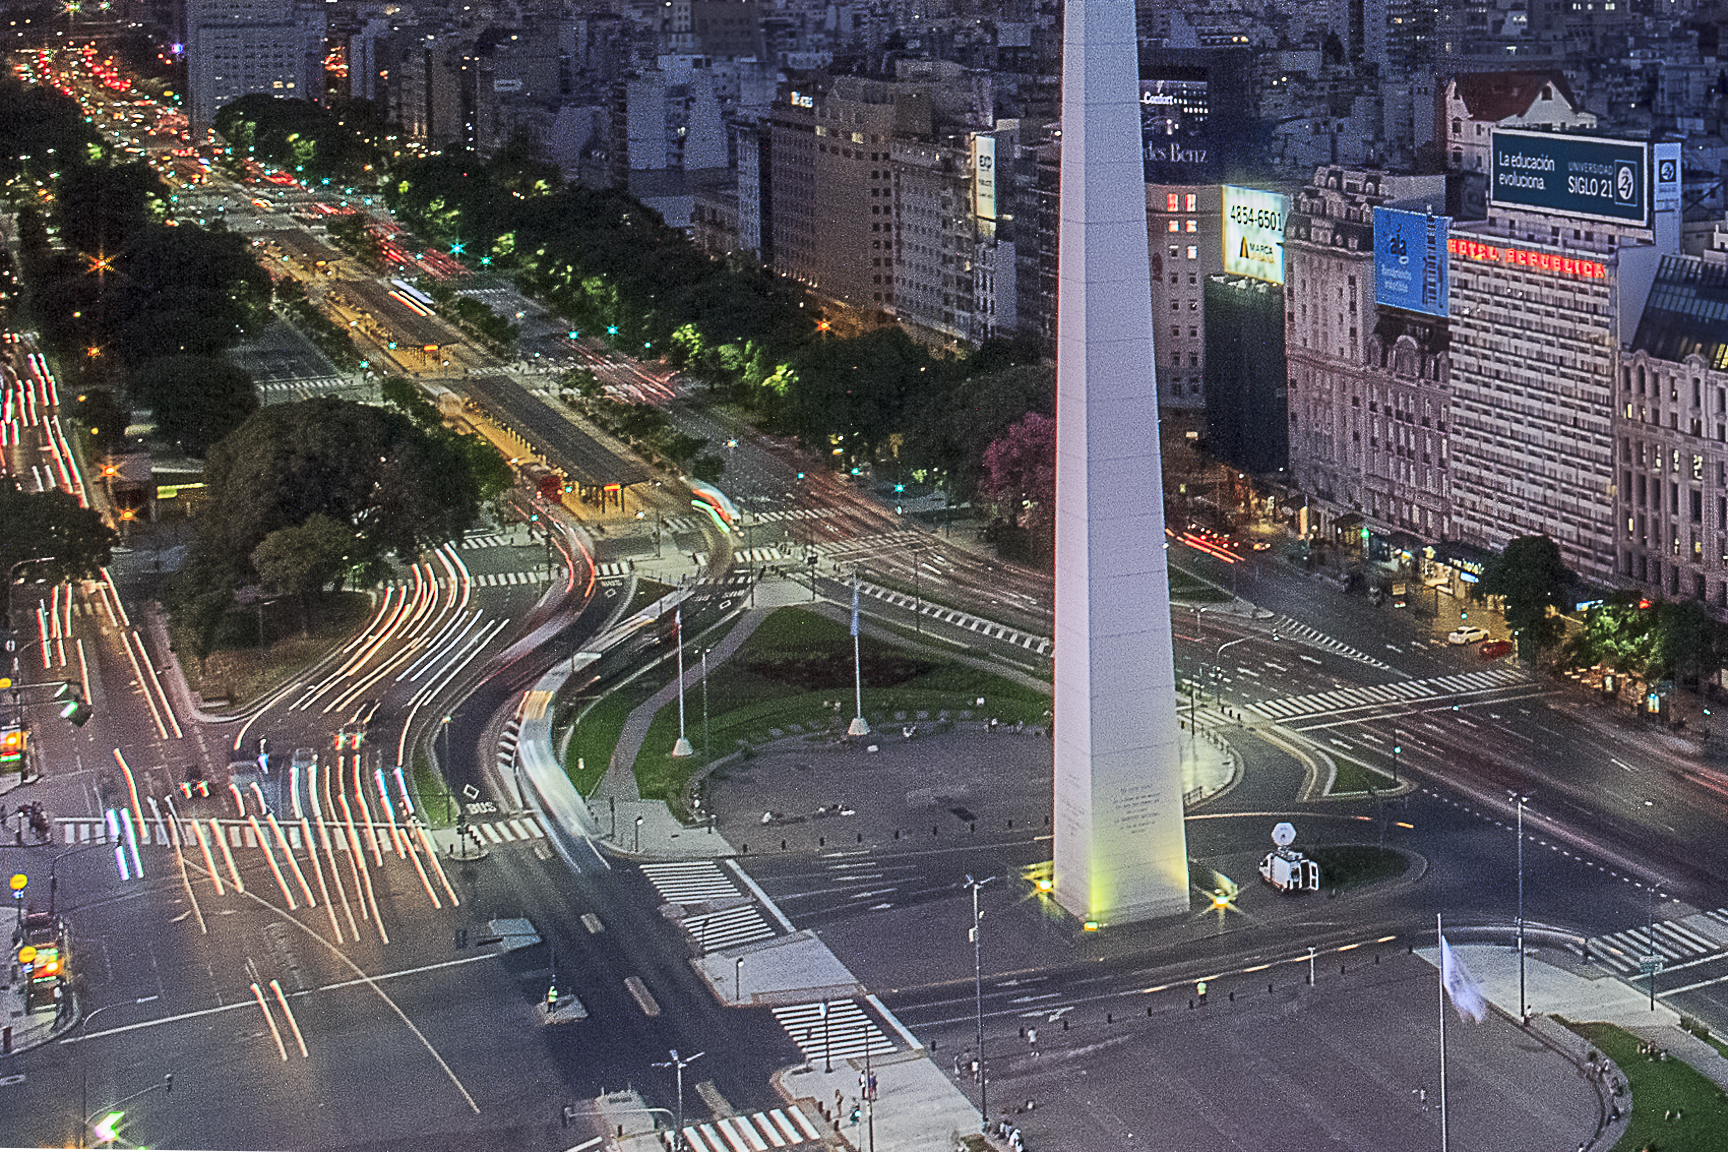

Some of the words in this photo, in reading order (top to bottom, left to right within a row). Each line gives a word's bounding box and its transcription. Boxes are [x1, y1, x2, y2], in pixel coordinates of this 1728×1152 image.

[1499, 150, 1510, 167] La
[1511, 151, 1555, 172] educación
[1568, 161, 1613, 176] UNIVERSIDAD
[1568, 176, 1598, 196] SIGLO
[1601, 180, 1613, 198] 21
[1230, 205, 1282, 232] 4854-6501
[1447, 239, 1500, 262] HOTEL
[1506, 248, 1605, 278] REPUBLICA
[466, 801, 497, 815] BUS
